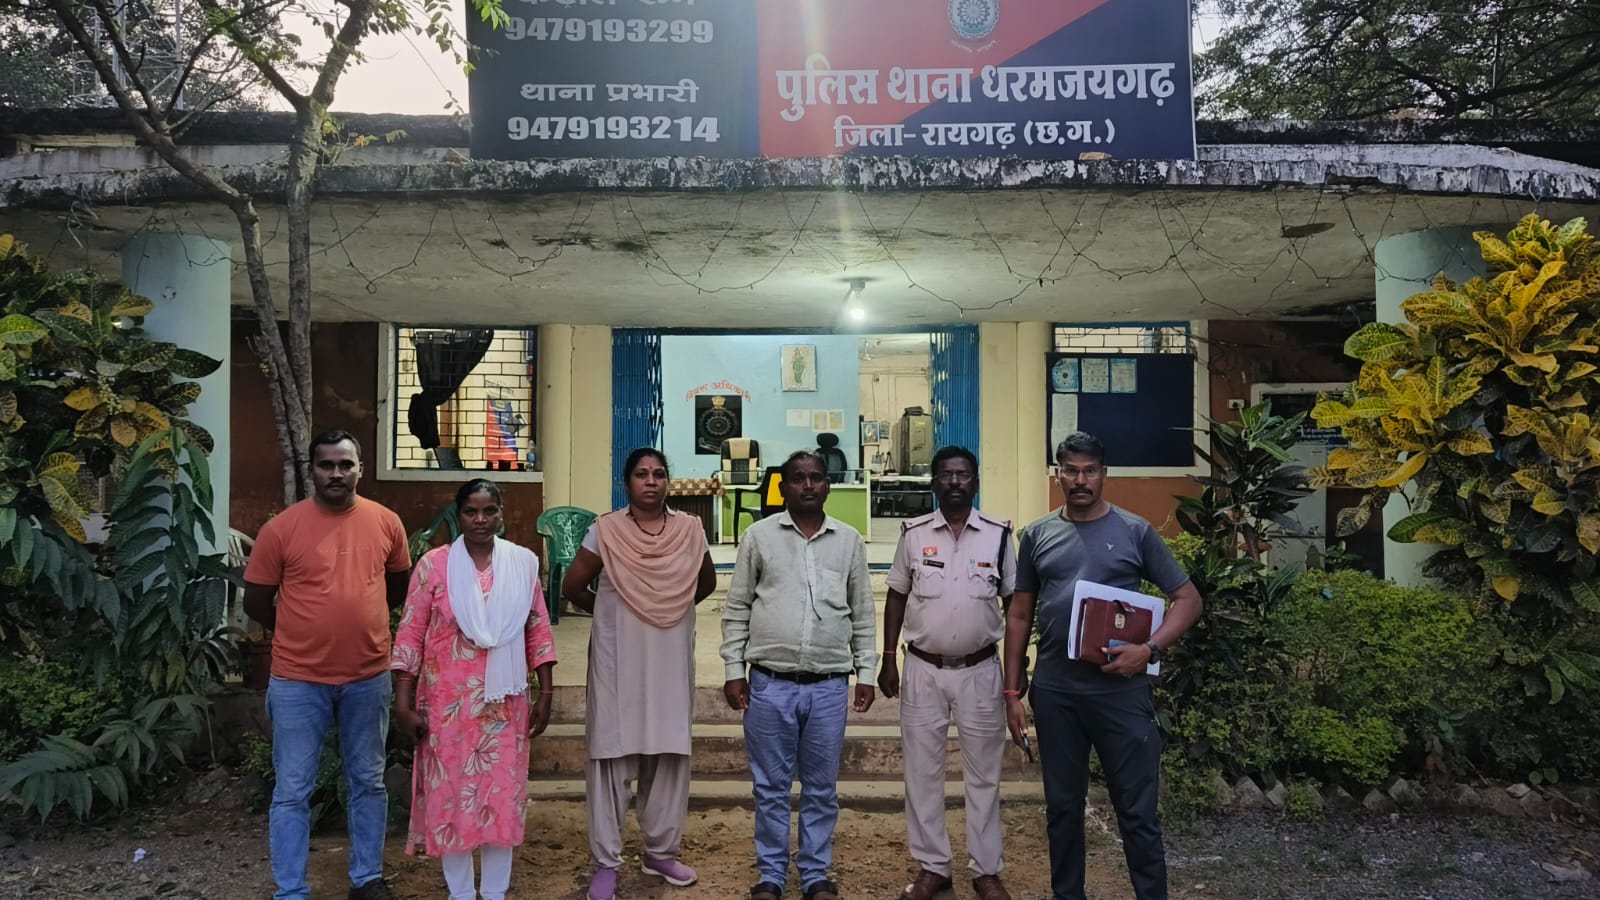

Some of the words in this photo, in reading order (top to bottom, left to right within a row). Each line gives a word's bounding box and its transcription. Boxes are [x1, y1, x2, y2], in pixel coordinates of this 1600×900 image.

[505, 16, 714, 44] 9479193299
[519, 83, 597, 102] थाना
[605, 79, 700, 103] प्रभारी
[776, 53, 879, 123] पुलिस
[887, 66, 974, 104] थाना
[981, 62, 1176, 107] धरमजयगढ़
[507, 115, 721, 143] 9479193214
[1024, 118, 1115, 146] (छ.ग.)
